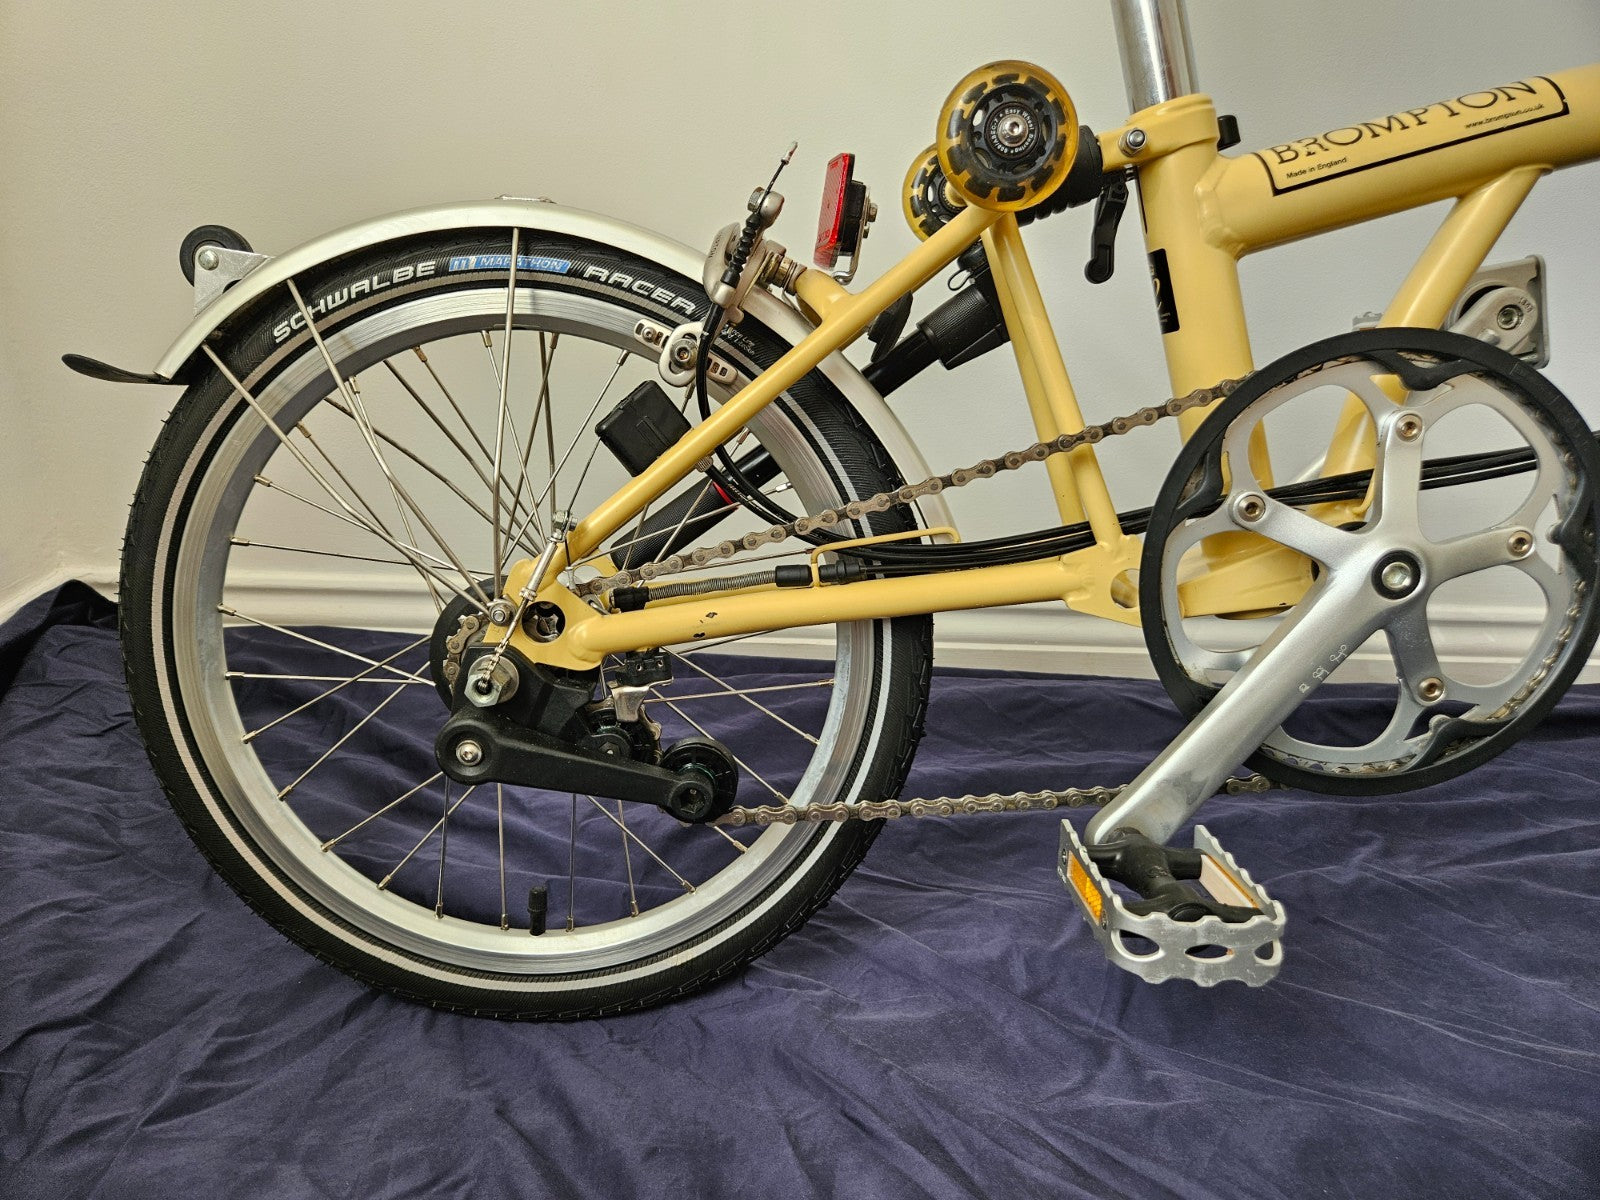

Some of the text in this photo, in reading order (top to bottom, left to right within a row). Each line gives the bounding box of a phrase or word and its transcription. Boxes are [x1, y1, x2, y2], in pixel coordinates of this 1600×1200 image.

[1270, 80, 1538, 165] BROMPTON
[1286, 168, 1307, 179] Made
[1317, 156, 1347, 171] England
[273, 256, 697, 344] SCHWALBE MARATHON RACER
